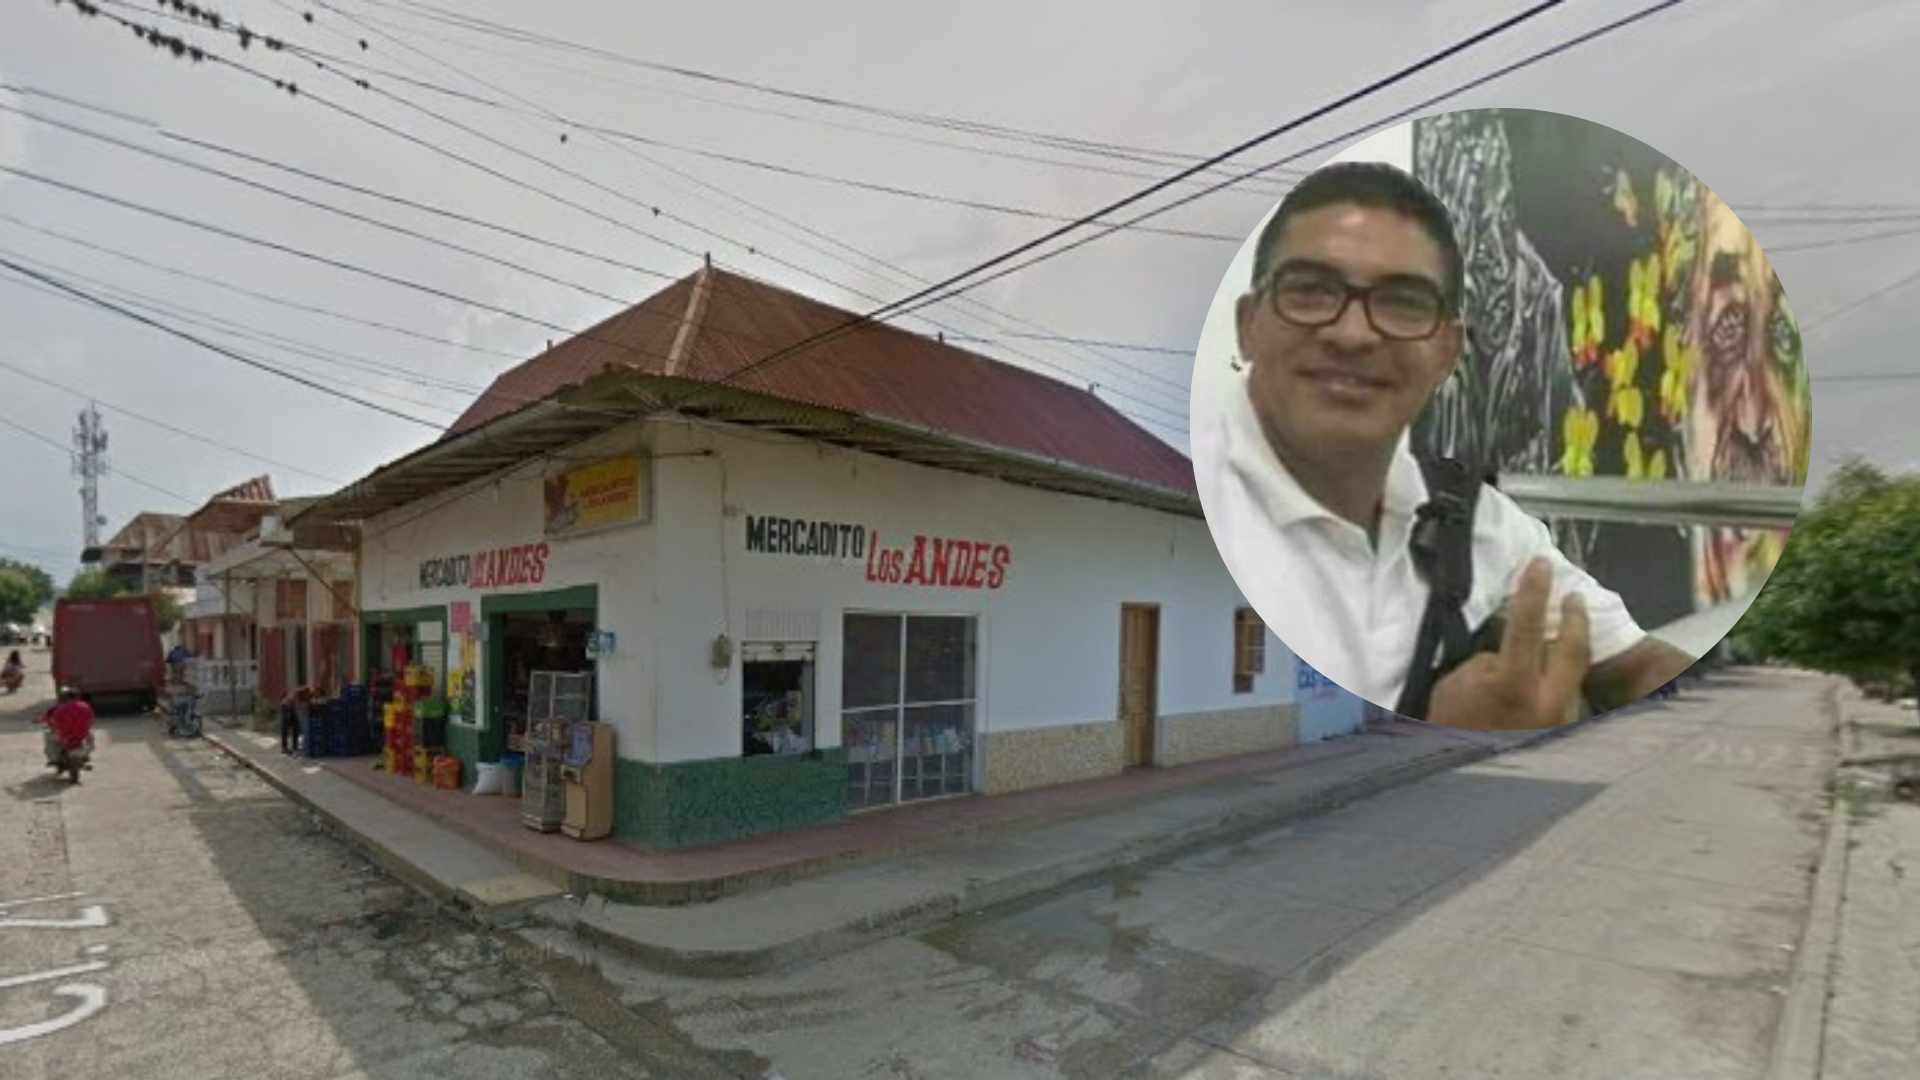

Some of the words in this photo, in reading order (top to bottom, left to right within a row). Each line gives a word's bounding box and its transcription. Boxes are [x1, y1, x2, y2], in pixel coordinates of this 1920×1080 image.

[486, 542, 550, 588] ANDES
[745, 514, 865, 559] MERCADITO
[904, 535, 1011, 590] ANDES
